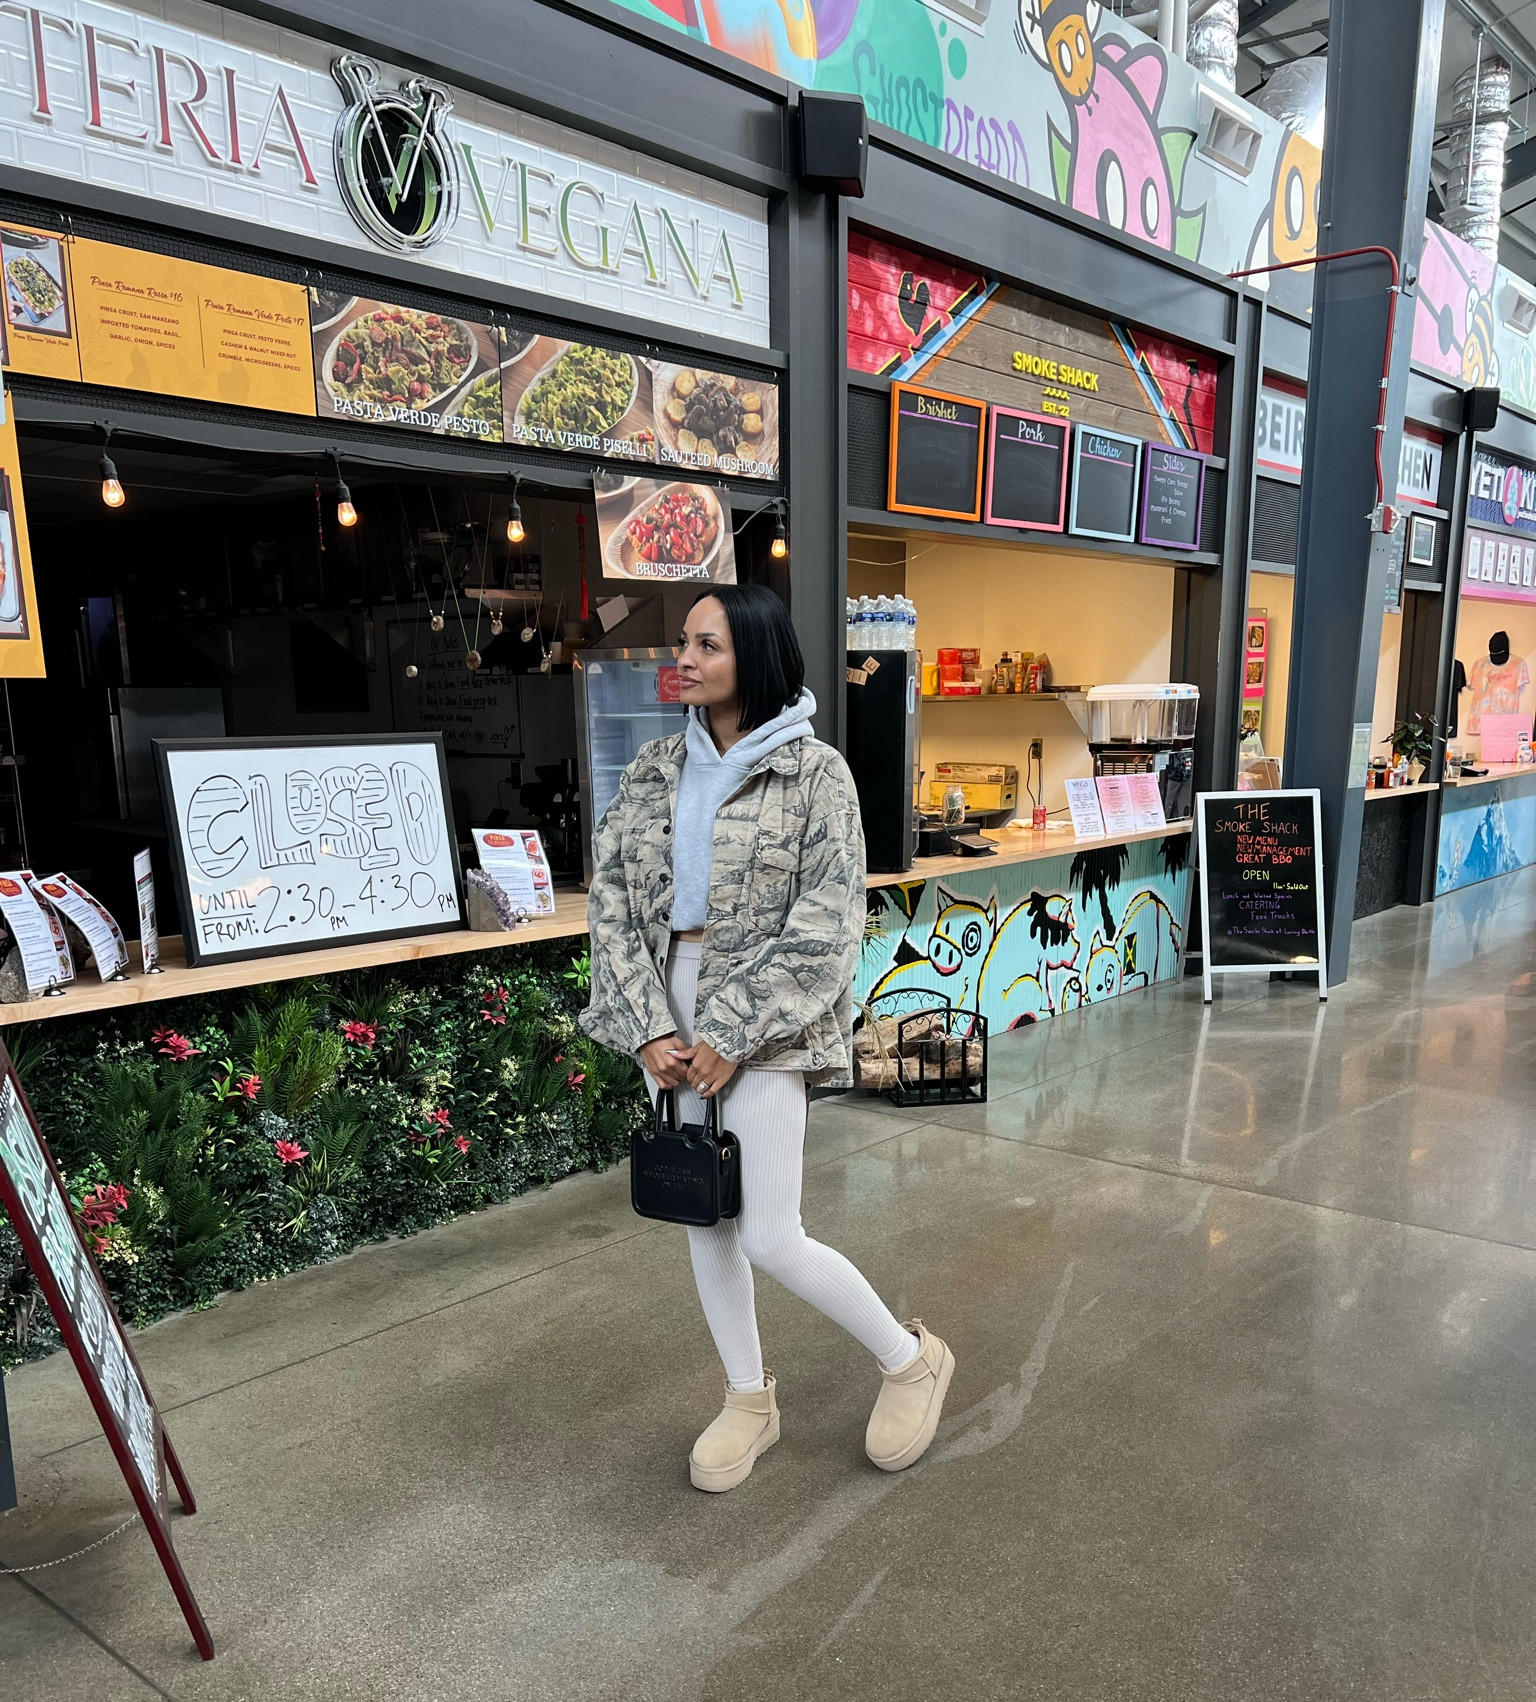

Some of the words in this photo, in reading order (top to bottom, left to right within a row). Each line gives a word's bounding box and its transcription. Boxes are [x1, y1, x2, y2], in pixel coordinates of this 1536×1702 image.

[0, 2, 320, 192] TERIA
[459, 140, 744, 307] VEGANA
[169, 292, 183, 302] $16
[100, 306, 117, 314] PINSA
[118, 309, 138, 318] CRUST,
[152, 314, 180, 325] MARZANO
[100, 318, 130, 329] IMPORTED
[131, 323, 163, 335] TOMATOES,
[164, 329, 181, 339] BASIL,
[223, 329, 239, 337] PINSA
[258, 335, 274, 343] PESTO
[275, 338, 292, 347] VERDE,
[109, 333, 133, 343] GARLIC,
[134, 338, 155, 347] ONION,
[156, 342, 176, 350] SPICES
[221, 341, 243, 350] CASHEW
[249, 346, 270, 355] WALNUT
[270, 349, 286, 357] MIXED
[218, 352, 244, 363] CRUMBLE,
[245, 357, 282, 369] MICROGREENS,
[283, 364, 301, 372] SPICES
[1011, 351, 1058, 380] SMOKE
[1059, 362, 1099, 392] SHACK
[333, 398, 386, 420] PASTA
[387, 404, 441, 429] VERDE
[443, 411, 491, 437] PESTO
[917, 396, 959, 421] Brisket
[512, 423, 555, 443] PASTA
[556, 429, 601, 451] VERDE
[602, 435, 649, 457] PISELLI
[1018, 420, 1046, 443] Pork
[1088, 436, 1123, 460] Chicken
[660, 448, 711, 468] SAUTEED
[713, 454, 777, 477] MUSHROOM
[1162, 454, 1187, 473] Sides
[1161, 516, 1172, 524] Fries
[635, 562, 711, 580] BRUSCHETTA
[187, 761, 441, 878] CLOSED
[1234, 802, 1270, 821] THE
[1214, 819, 1252, 834] SMOKE
[1261, 822, 1299, 835] SHACK
[1237, 835, 1253, 844] NEW
[1254, 836, 1278, 846] MENU
[1235, 854, 1267, 864] GREAT
[1271, 855, 1293, 865] BBQ
[1254, 845, 1312, 856] MANAGEMENT
[1242, 870, 1270, 881] OPEN
[199, 889, 256, 915] UNTIL
[1222, 891, 1239, 900] Lunch
[1239, 900, 1280, 910] CATERING
[202, 918, 259, 943] FROM:
[257, 883, 335, 934] 2:30
[330, 915, 349, 931] PM
[359, 872, 436, 915] 4:30
[438, 892, 457, 913] PM
[1251, 911, 1268, 920] Food
[1270, 911, 1295, 920] Trucks
